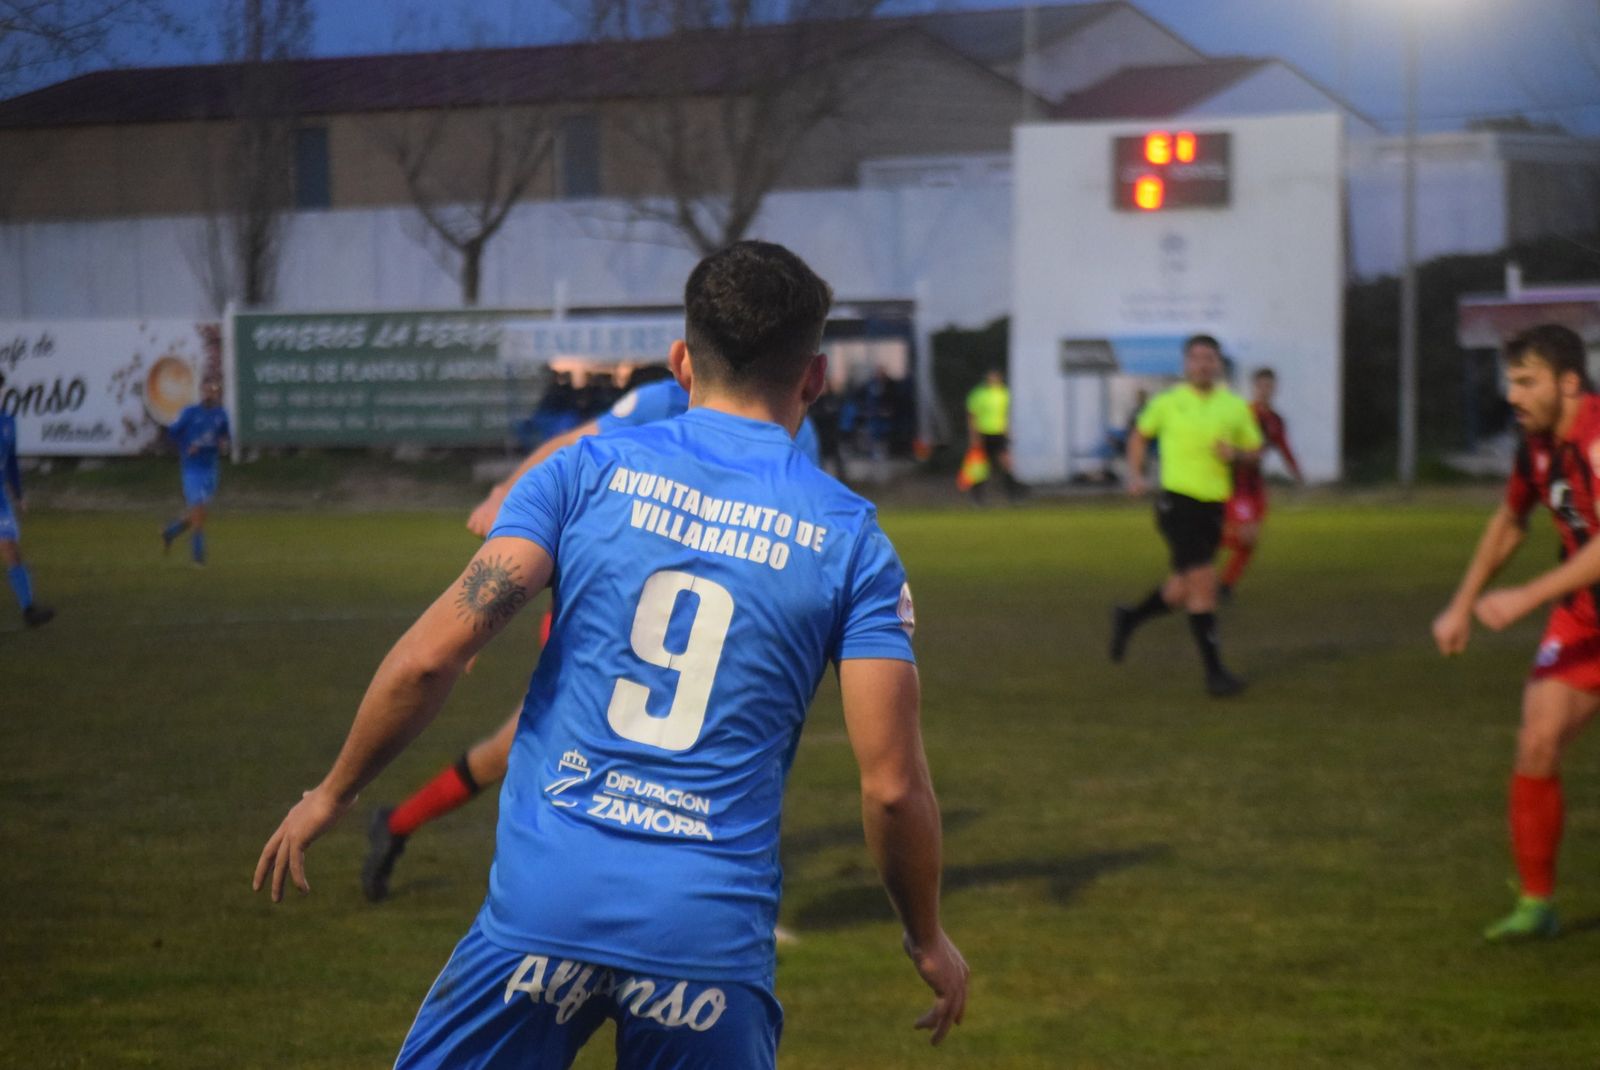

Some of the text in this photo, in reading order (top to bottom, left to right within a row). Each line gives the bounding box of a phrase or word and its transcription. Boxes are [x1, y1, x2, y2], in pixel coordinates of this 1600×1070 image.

[608, 467, 827, 553] AYUNTAMIENTO DE
[630, 500, 790, 570] VILLARALBO
[607, 570, 734, 750] 9
[587, 794, 713, 841] ZAMORA
